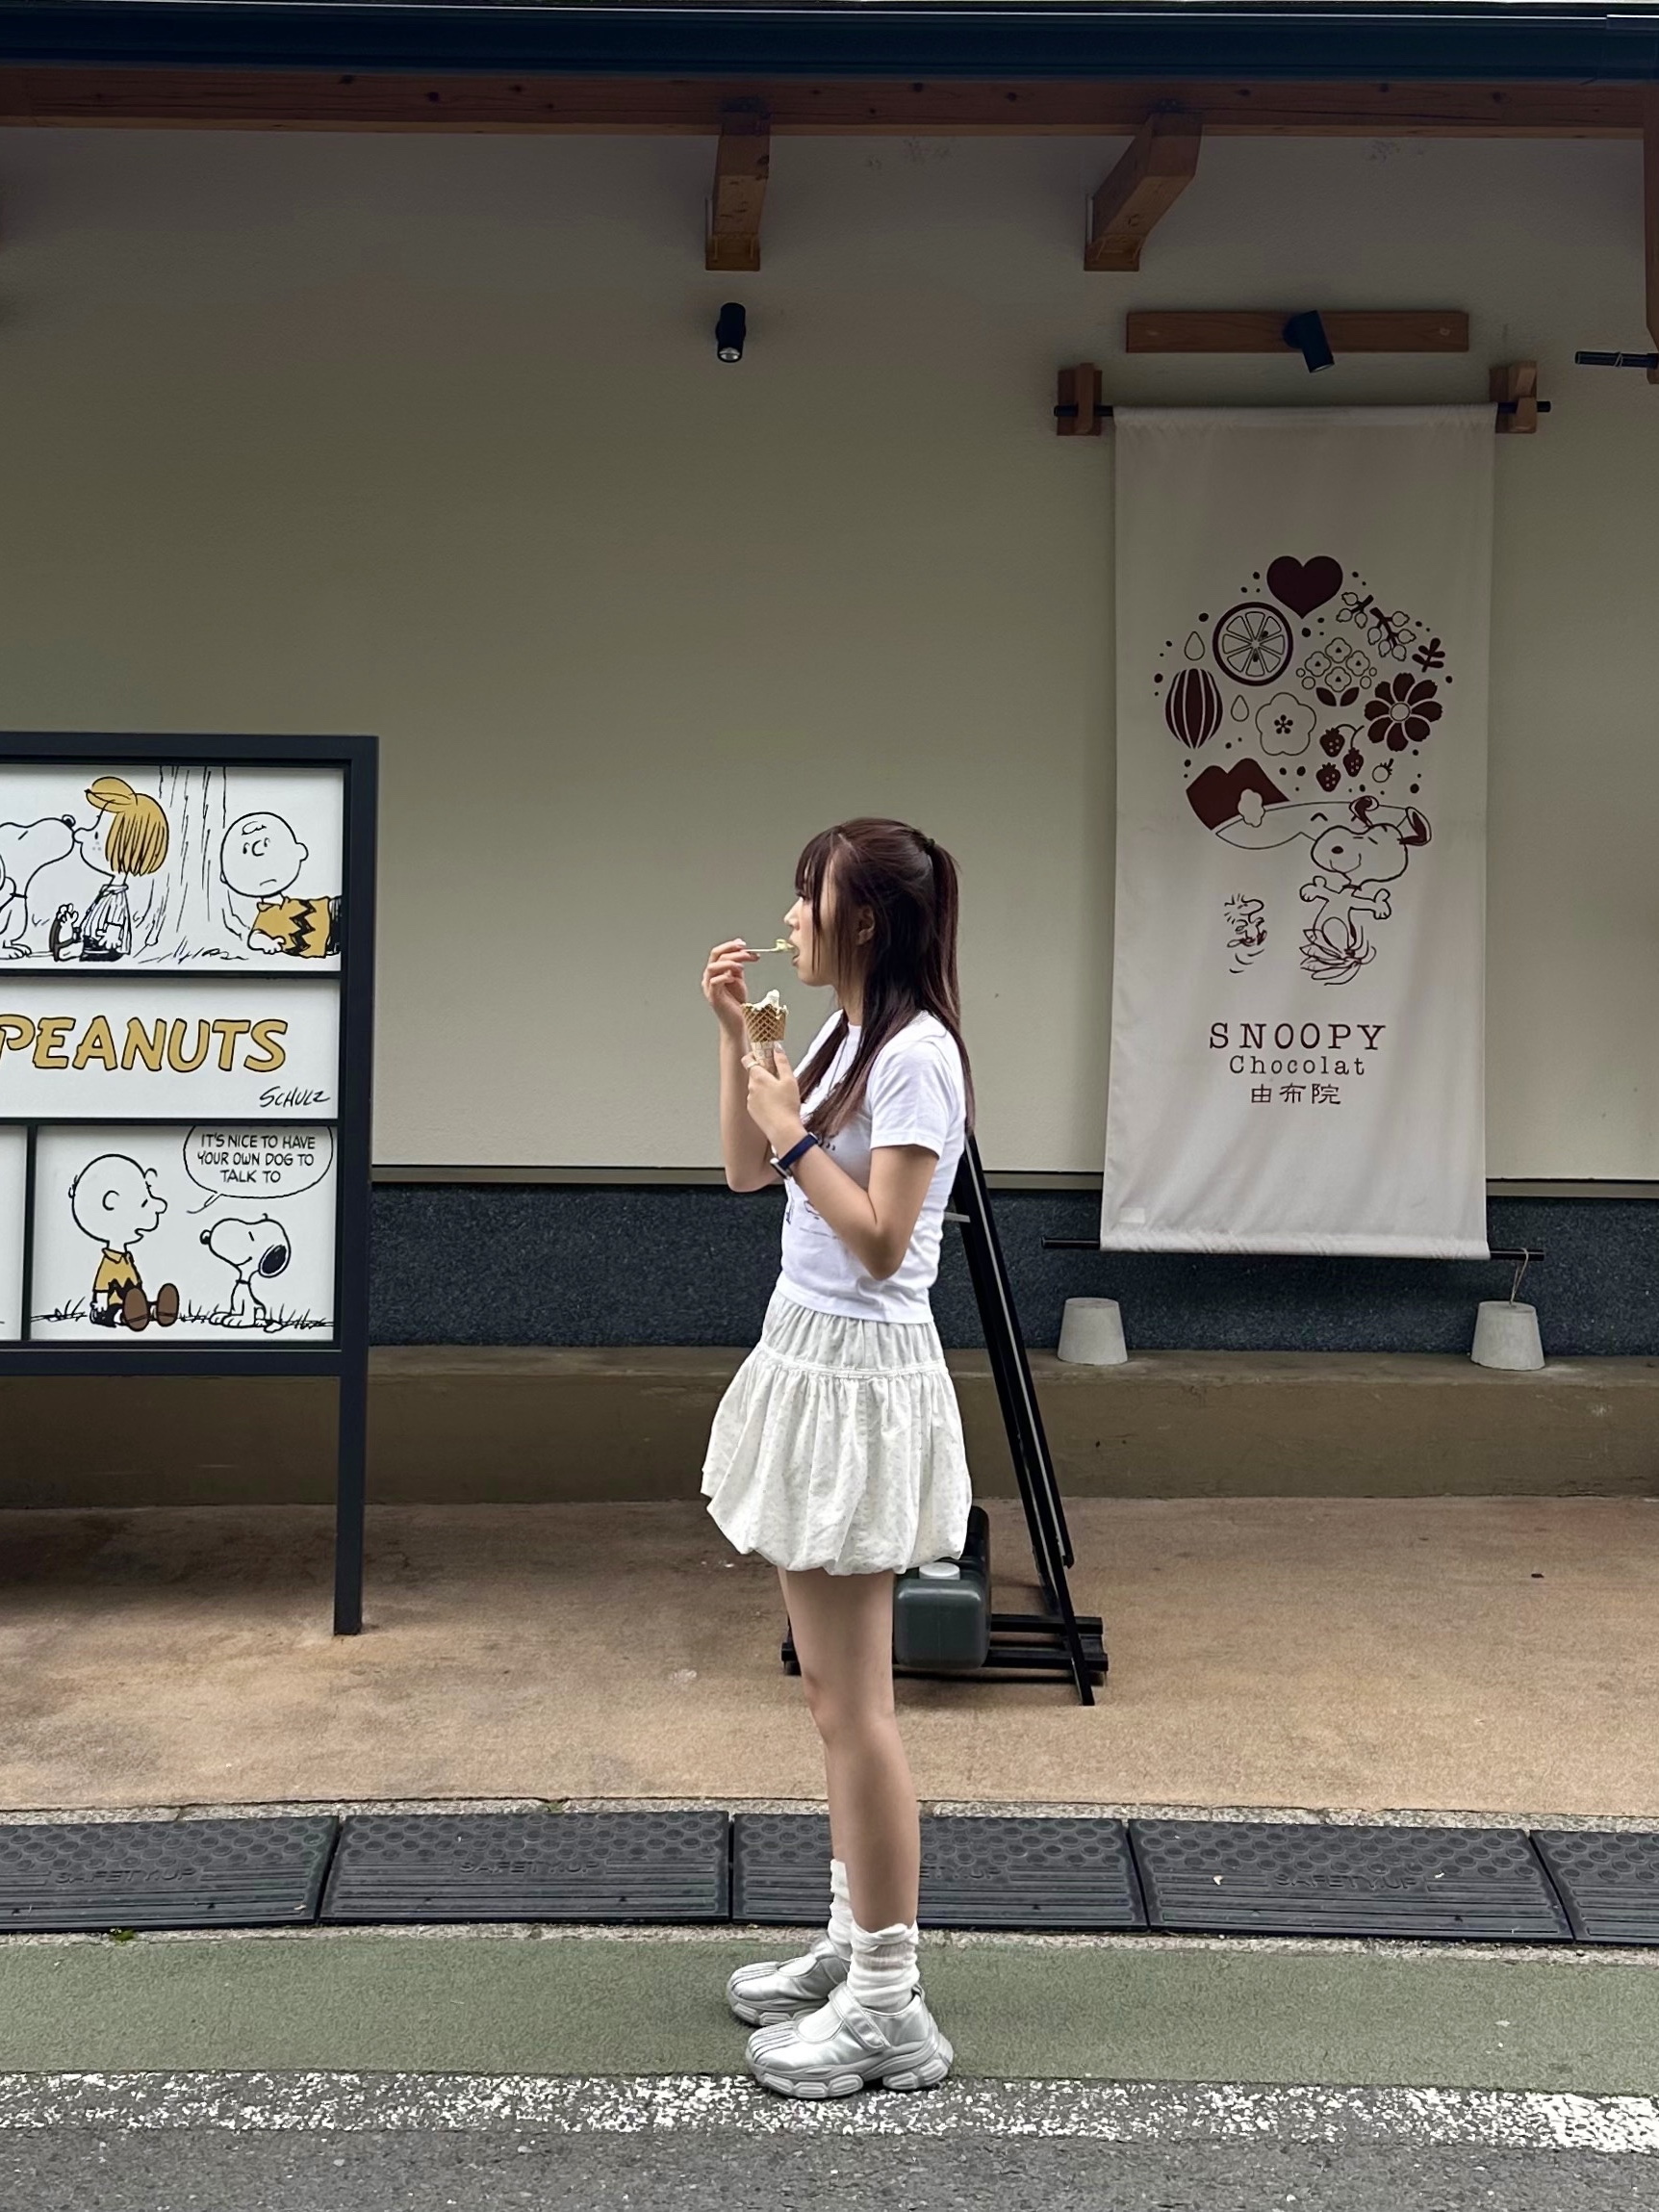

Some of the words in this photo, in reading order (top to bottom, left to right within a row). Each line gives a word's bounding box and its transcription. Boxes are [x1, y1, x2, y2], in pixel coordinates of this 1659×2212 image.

[0, 1014, 288, 1073] PEANUTS
[1209, 1022, 1387, 1051] SNOOPY
[1229, 1055, 1365, 1076] Chocolat
[259, 1085, 331, 1108] SCHULZ
[1250, 1082, 1341, 1105] 由布院
[201, 1133, 225, 1148] IT'S
[227, 1134, 258, 1148] NICE
[261, 1135, 278, 1148] TO
[282, 1135, 316, 1150] HAVE
[197, 1151, 229, 1166] YOUR
[233, 1152, 260, 1166] OWN
[265, 1152, 294, 1167] DOG
[297, 1153, 315, 1167] TO
[219, 1168, 257, 1184] TALK
[262, 1170, 281, 1184] TO
